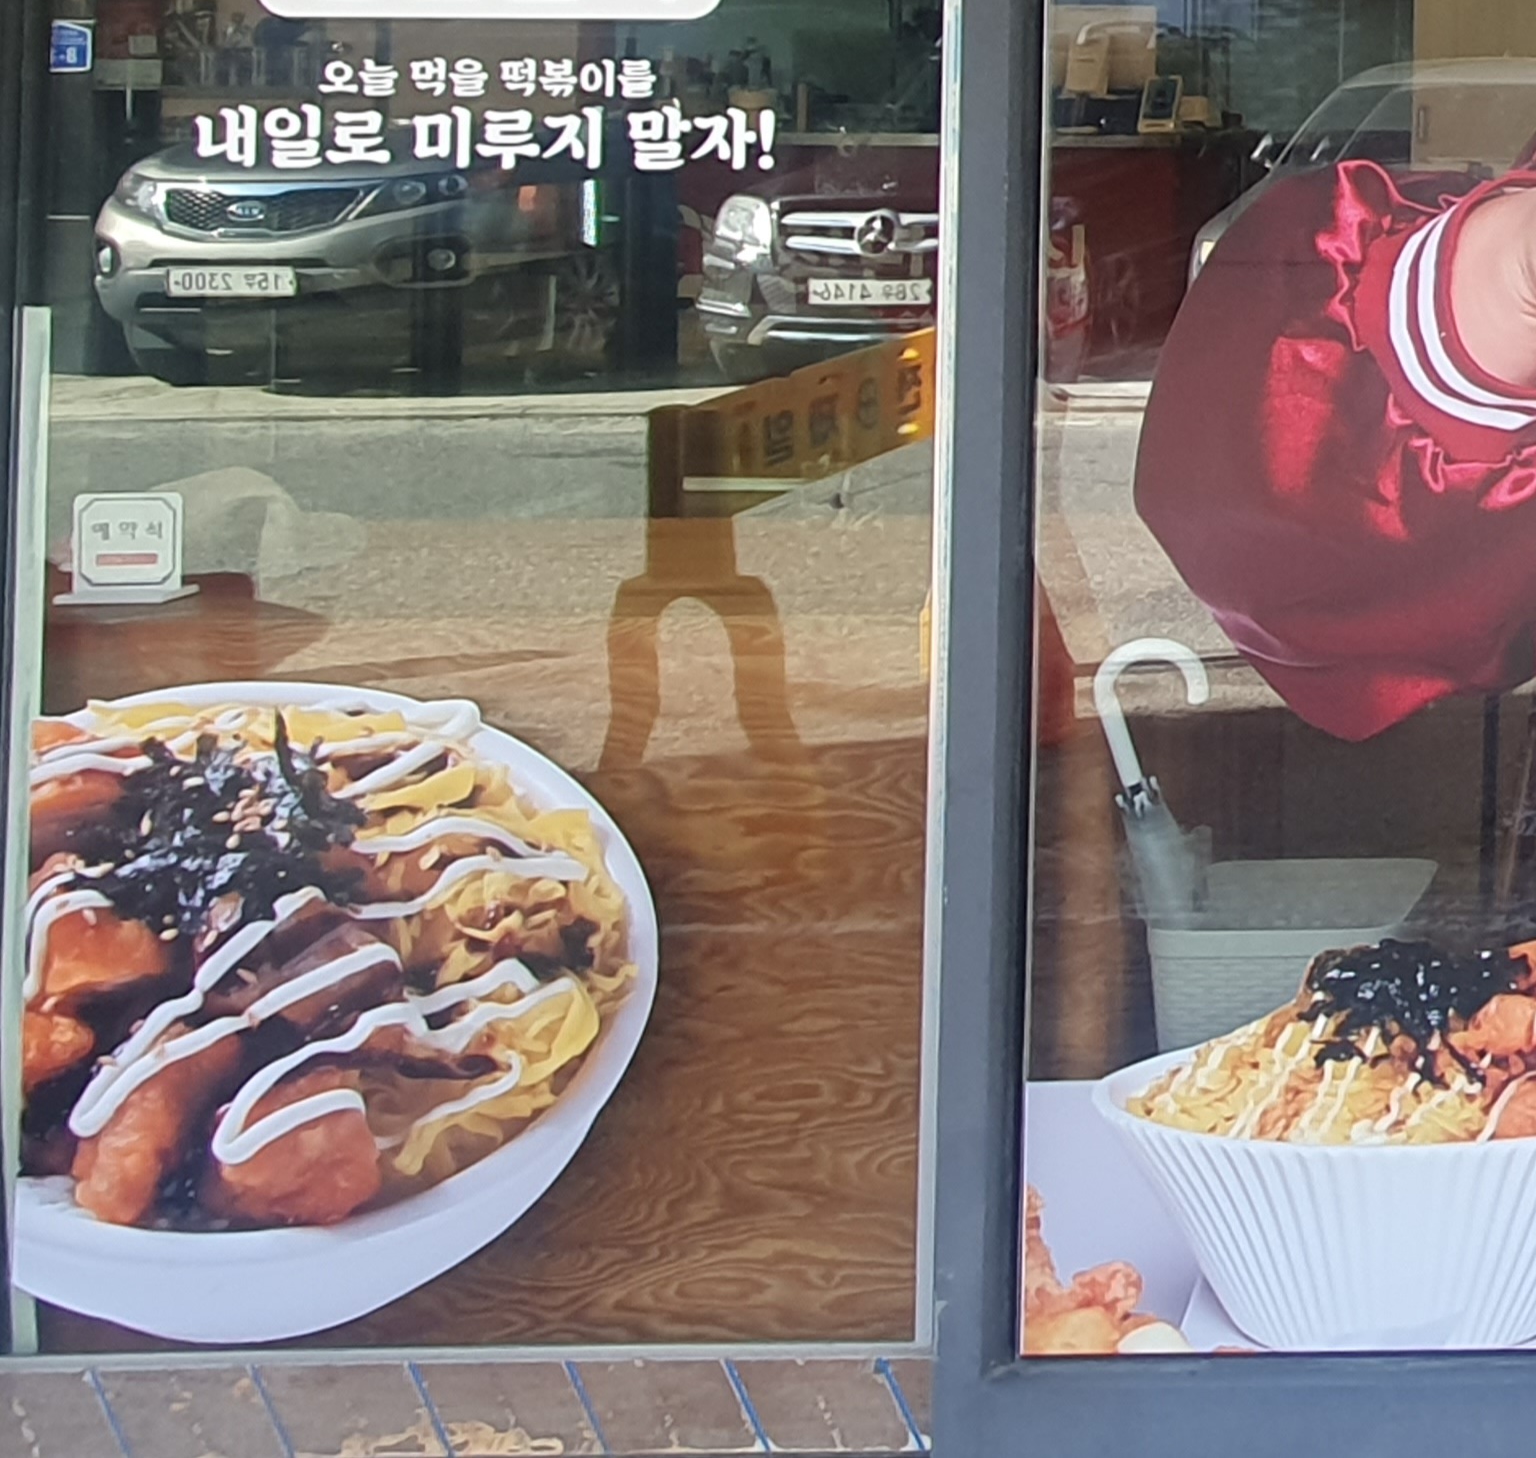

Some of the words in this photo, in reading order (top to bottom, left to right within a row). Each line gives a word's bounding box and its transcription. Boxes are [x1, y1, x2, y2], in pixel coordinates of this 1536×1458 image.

[318, 58, 399, 97] 오늘
[410, 57, 489, 97] 먹을
[500, 58, 657, 98] 떡볶이를
[195, 103, 391, 168] 내일로
[412, 105, 602, 170] 미루지
[626, 105, 776, 171] 말자!
